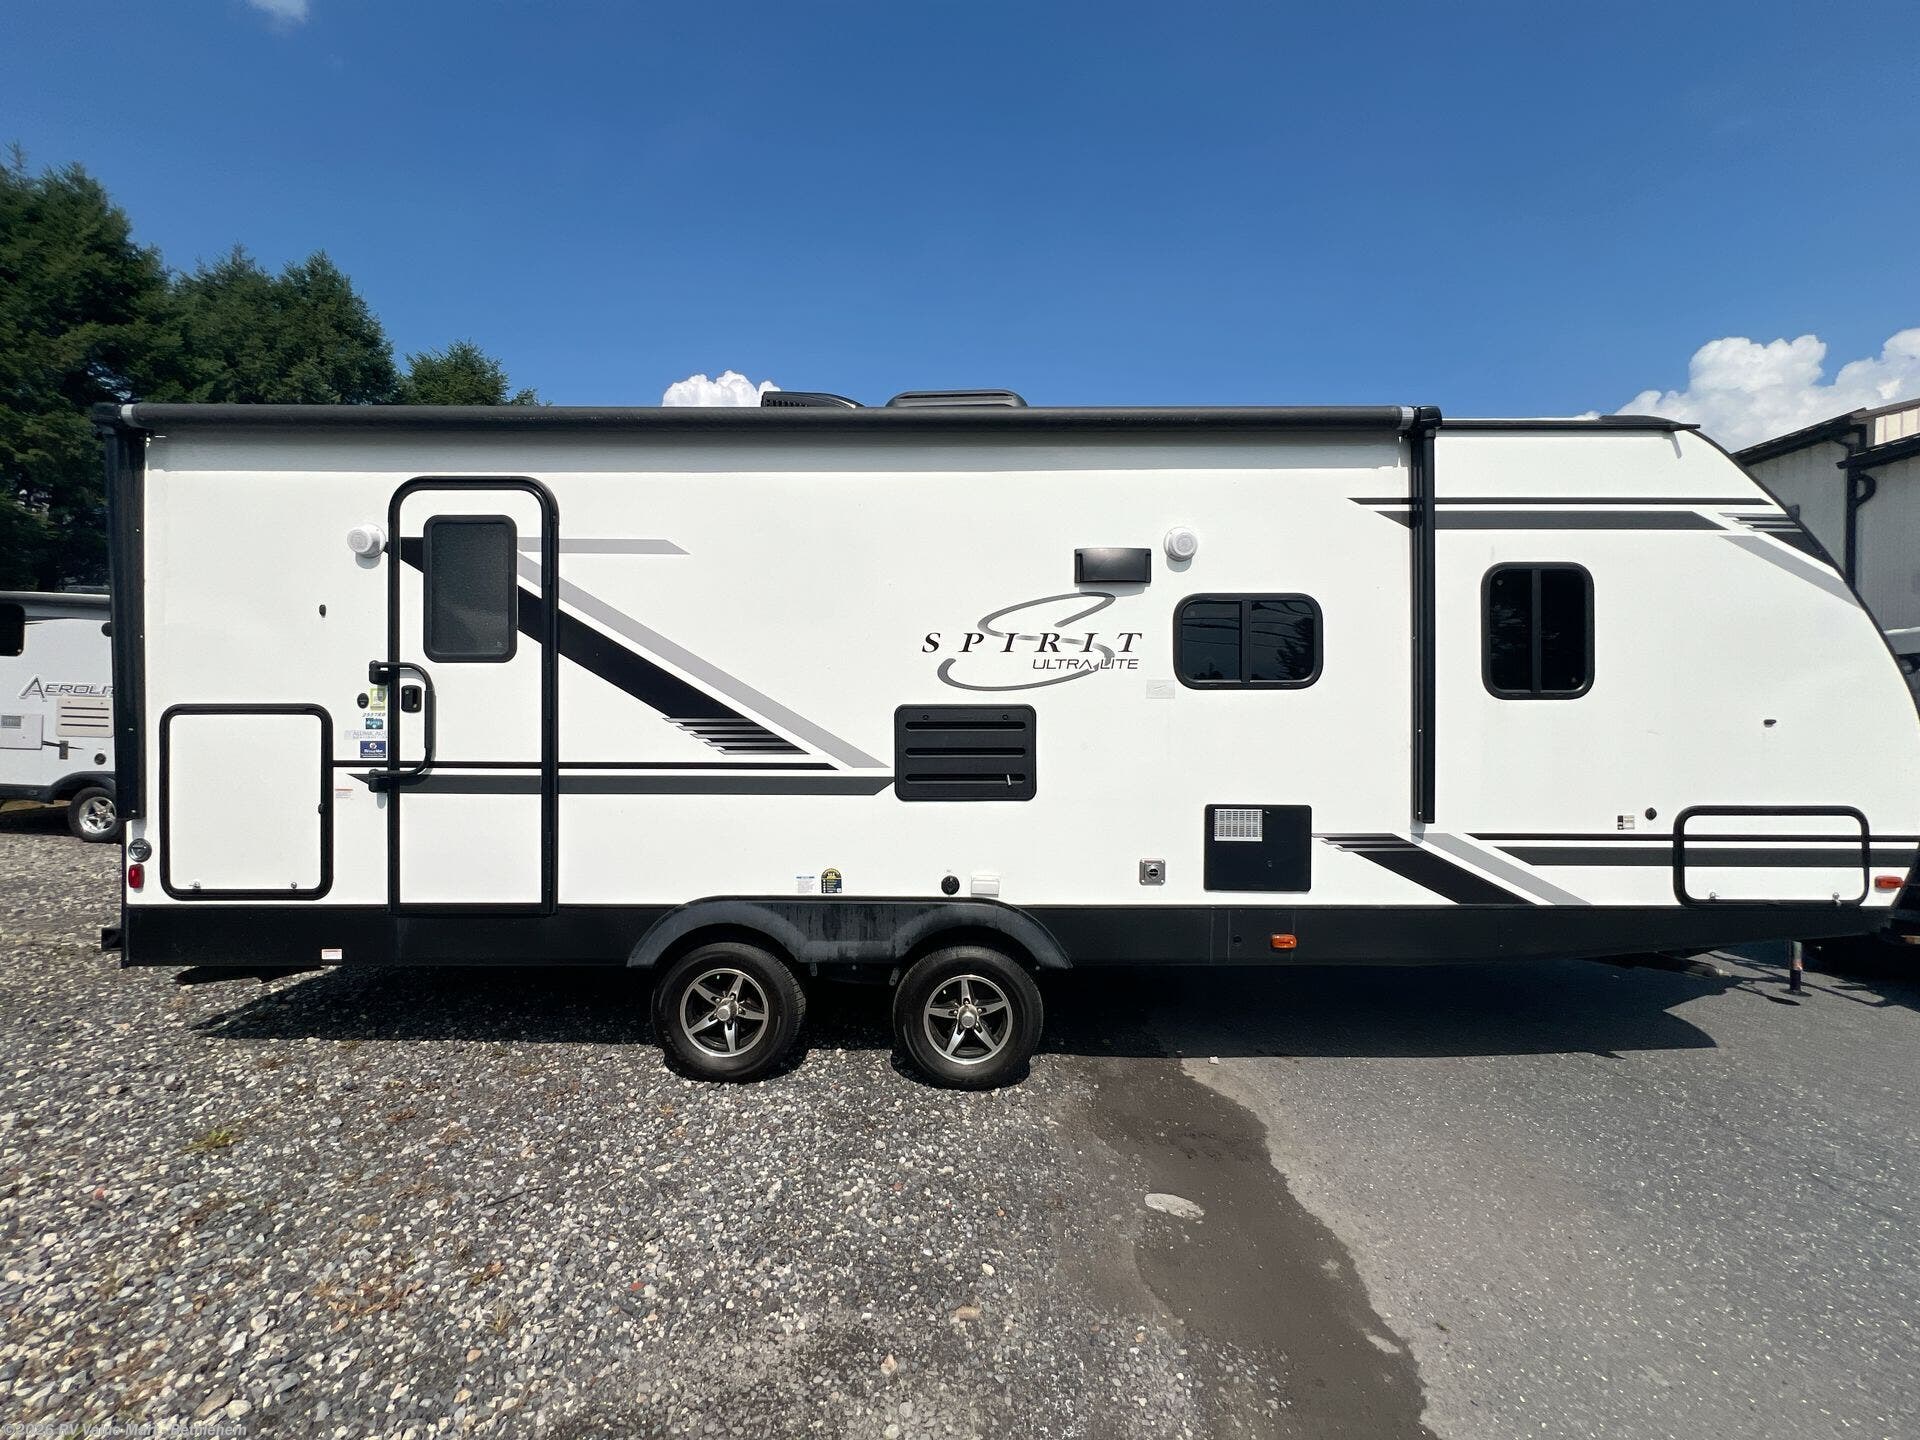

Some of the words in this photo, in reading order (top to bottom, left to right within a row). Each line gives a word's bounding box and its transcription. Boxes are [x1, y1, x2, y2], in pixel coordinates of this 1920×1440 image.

[921, 632, 1143, 653] SPIRIT
[1033, 658, 1093, 670] ULTRA
[1100, 658, 1139, 670] LITE
